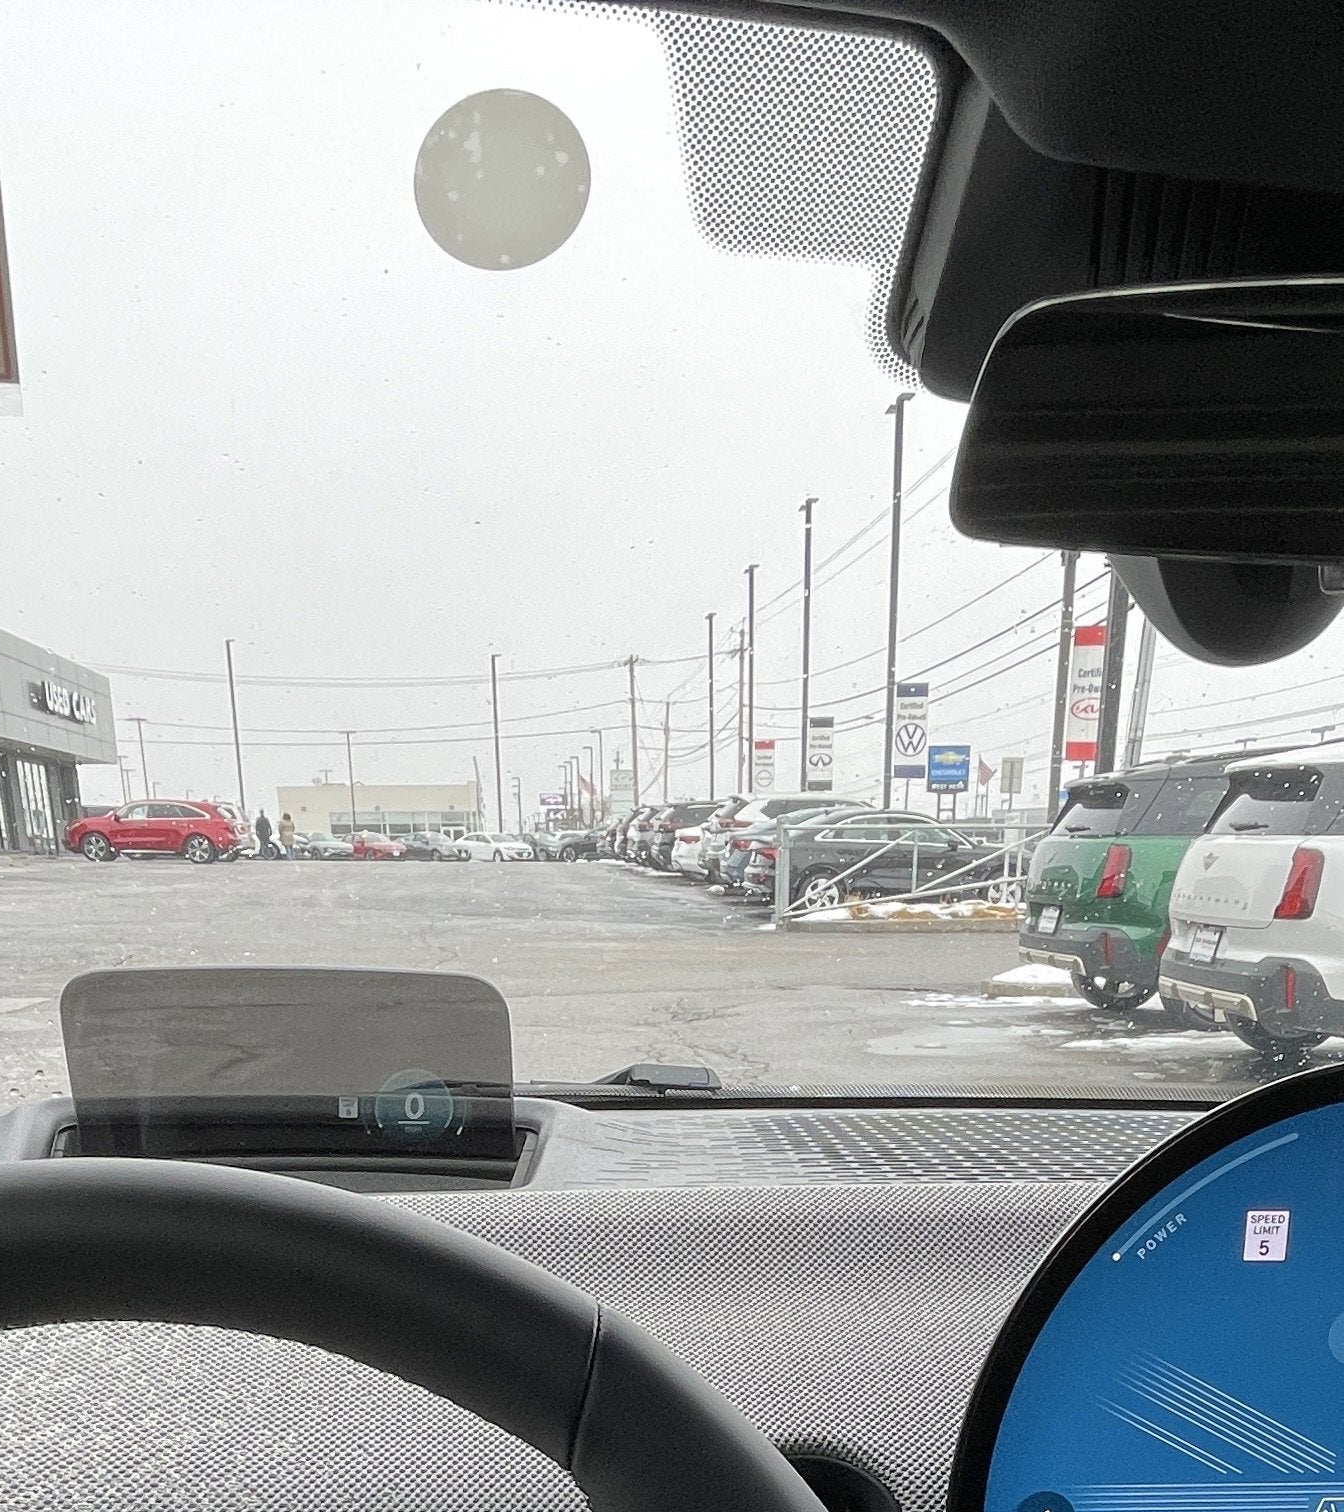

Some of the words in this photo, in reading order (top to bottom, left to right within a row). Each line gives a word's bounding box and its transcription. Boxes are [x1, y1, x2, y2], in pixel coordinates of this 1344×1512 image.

[1077, 667, 1103, 679] Certifi
[1072, 683, 1102, 694] Pre-Ow
[44, 680, 71, 717] USED
[72, 690, 97, 725] CARS
[404, 1092, 425, 1120] 0
[1250, 1213, 1286, 1226] SPEED
[1136, 1212, 1188, 1260] POWER
[1253, 1225, 1281, 1235] LIMIT
[1258, 1240, 1270, 1256] 5
